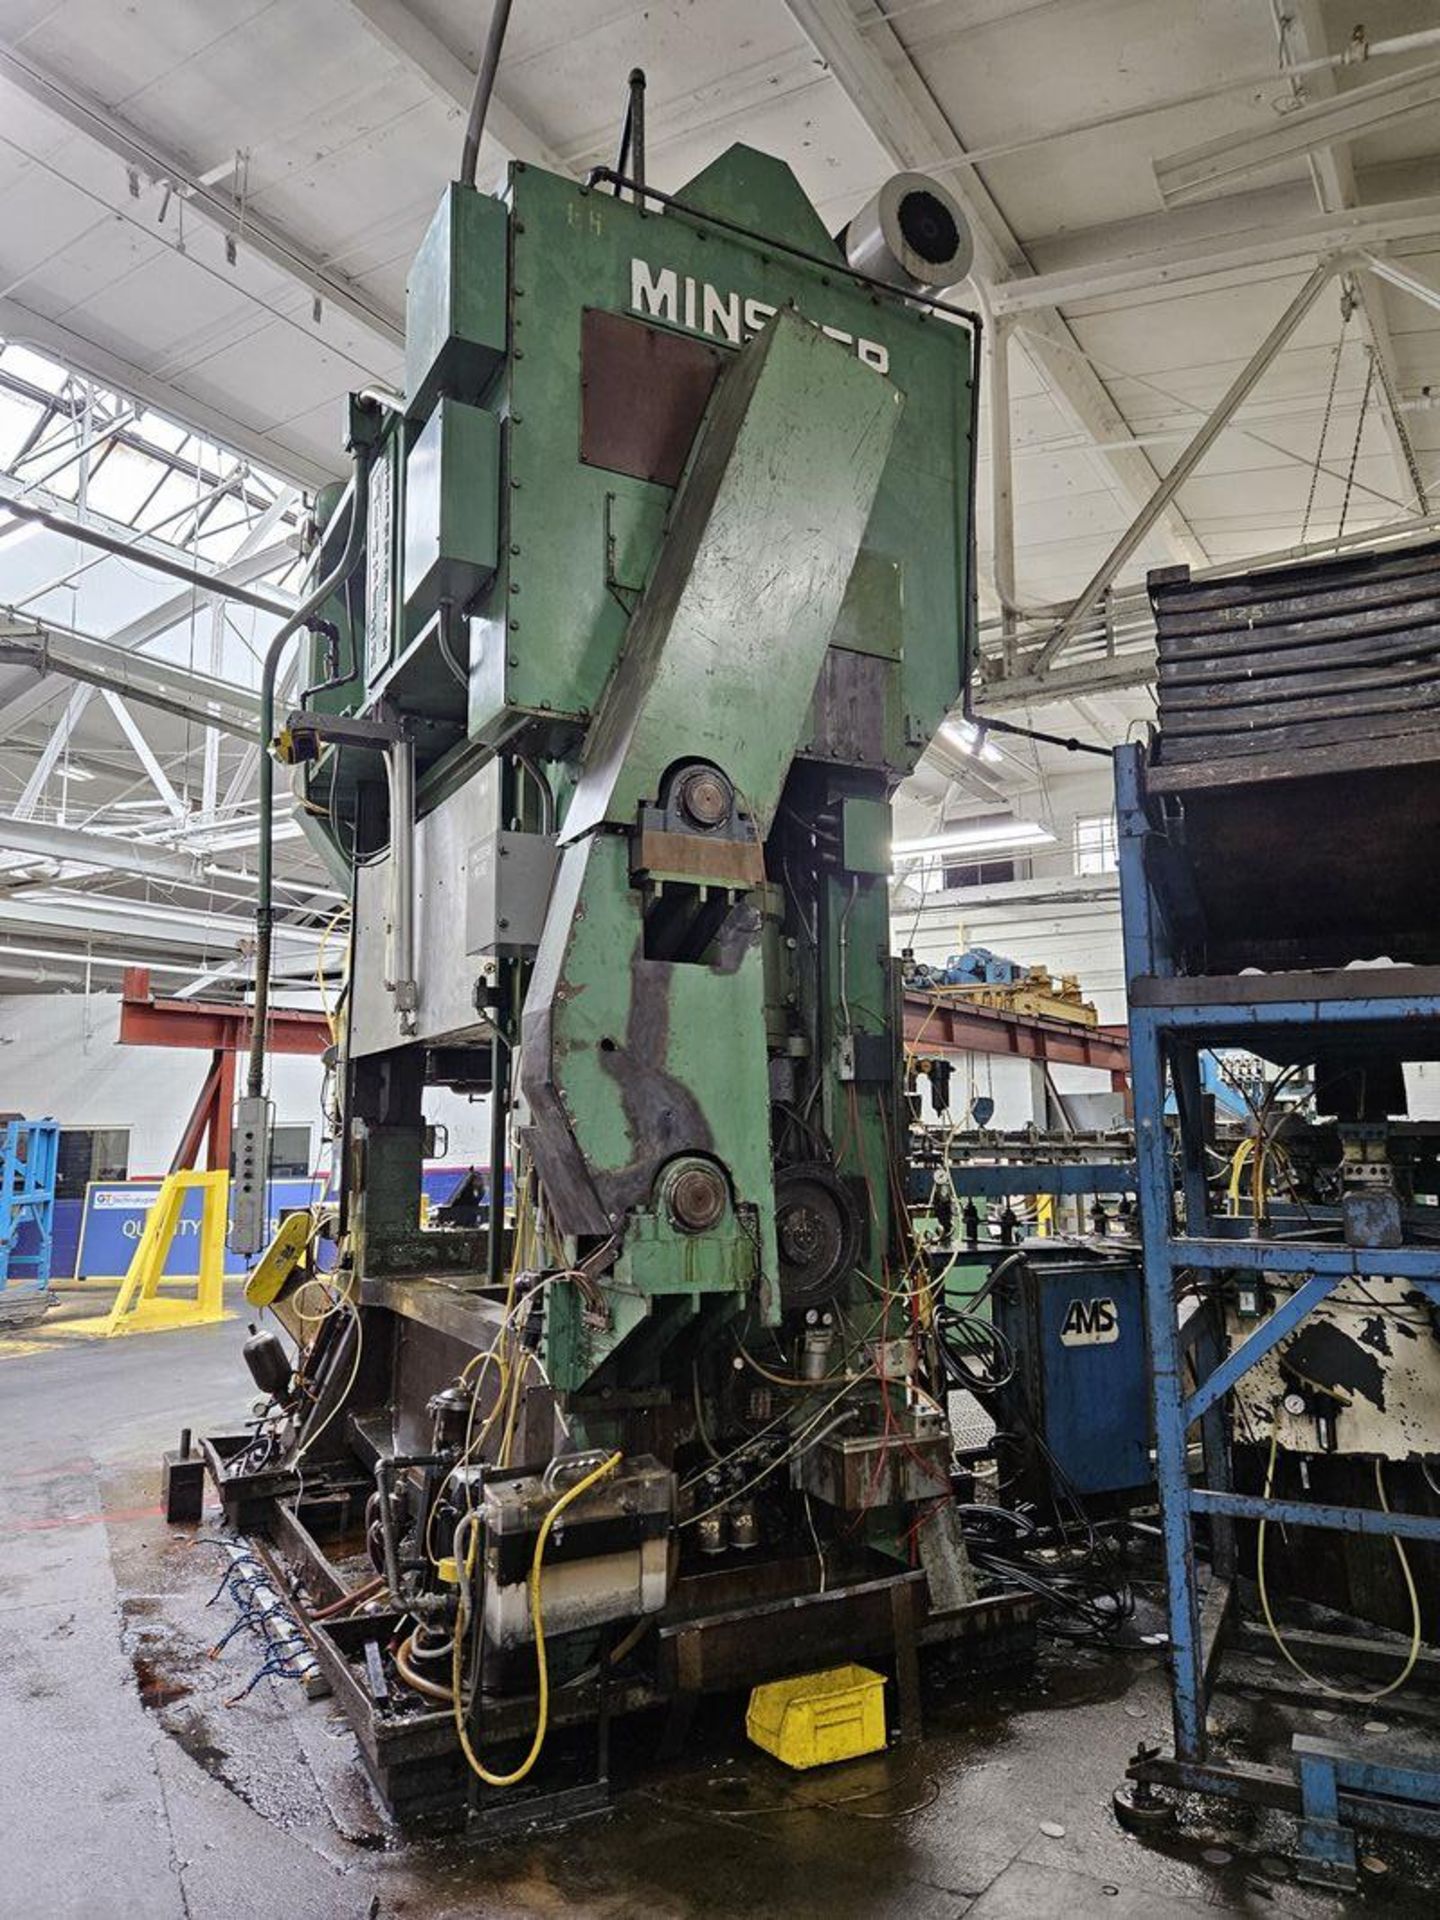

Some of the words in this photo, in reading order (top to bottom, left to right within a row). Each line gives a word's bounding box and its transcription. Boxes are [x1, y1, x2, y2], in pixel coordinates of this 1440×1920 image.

[631, 258, 890, 374] MINSR
[122, 1219, 202, 1239] QUITY
[1060, 1298, 1115, 1336] AMS
